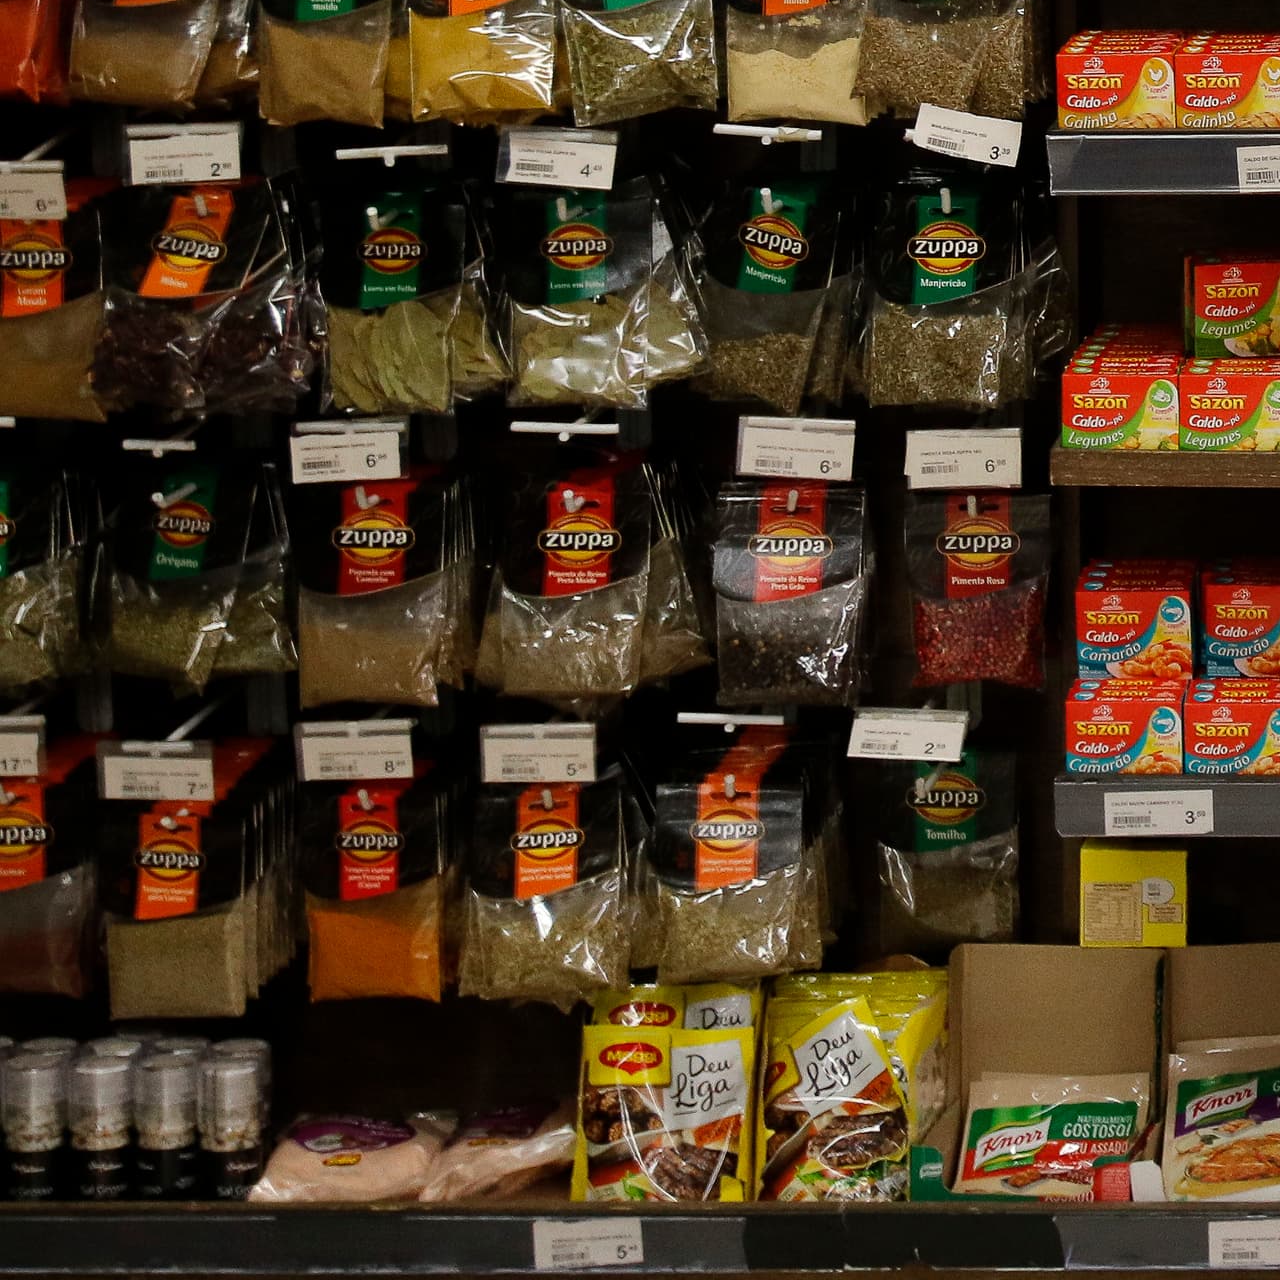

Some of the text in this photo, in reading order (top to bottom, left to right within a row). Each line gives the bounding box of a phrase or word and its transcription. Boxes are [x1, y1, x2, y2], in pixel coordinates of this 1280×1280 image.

[1182, 110, 1236, 128] Galinha
[920, 277, 967, 289] Manjericão
[1068, 429, 1124, 448] Legumes
[339, 528, 409, 547] zuppa
[1079, 642, 1142, 661] Camarão
[926, 829, 967, 841] Tomilho
[688, 1054, 731, 1073] Deu
[670, 1073, 731, 1111] Liga
[1191, 1088, 1255, 1118] Knorr
[983, 1127, 1048, 1156] Knorr
